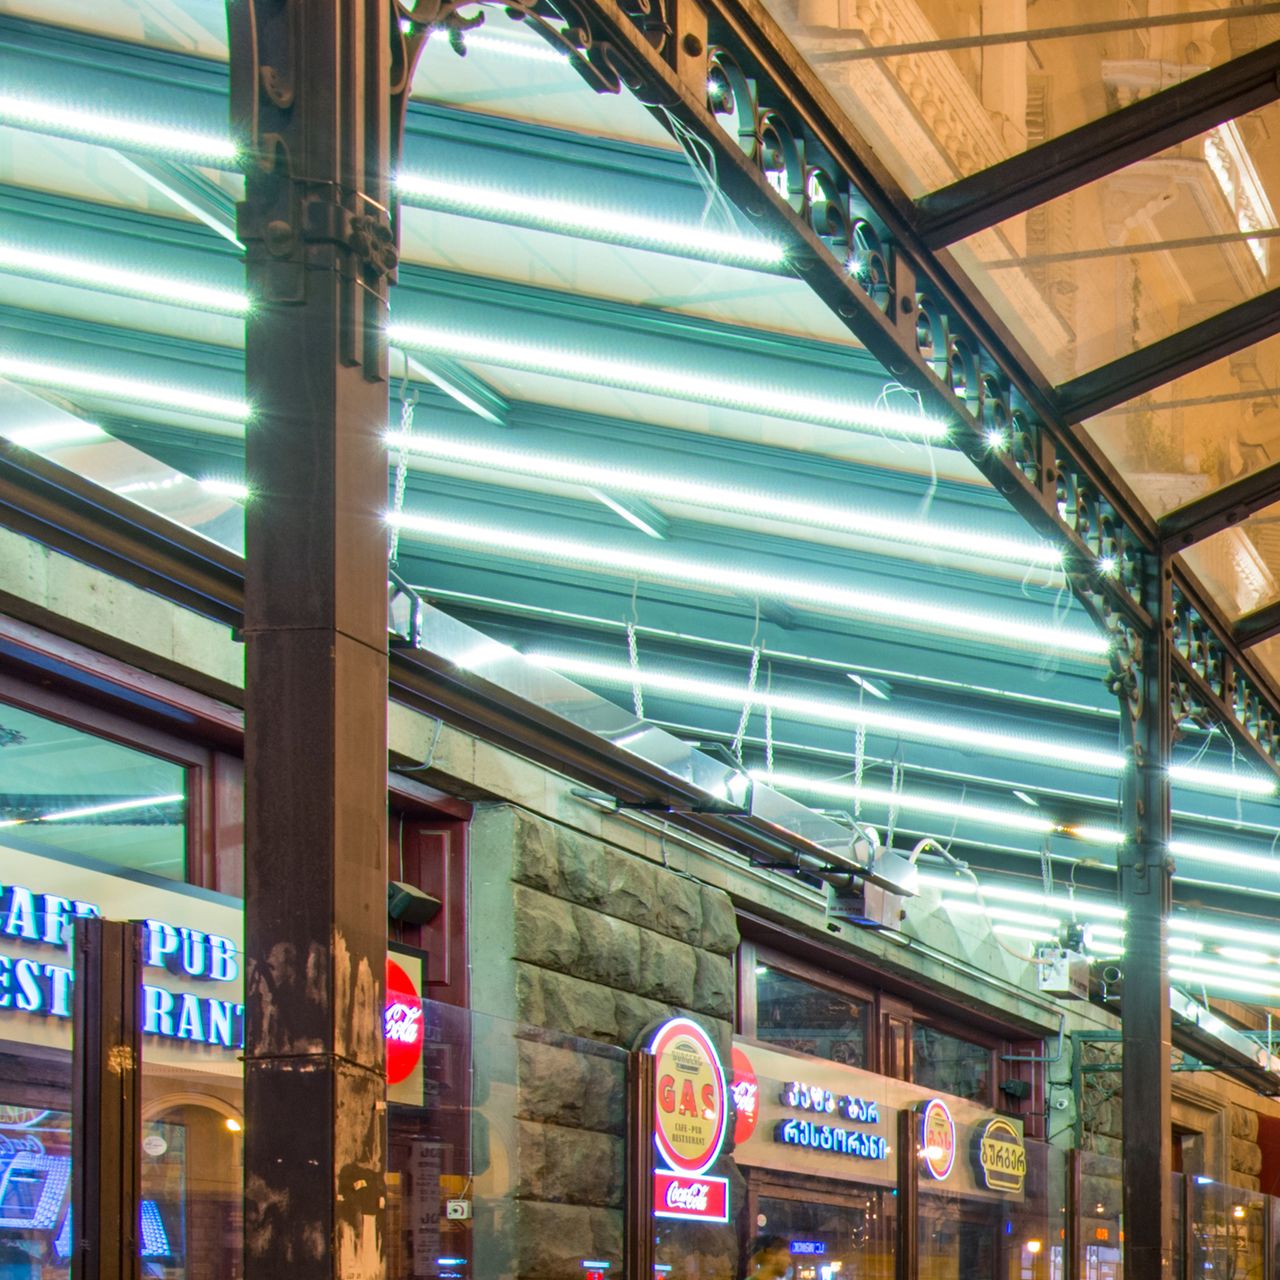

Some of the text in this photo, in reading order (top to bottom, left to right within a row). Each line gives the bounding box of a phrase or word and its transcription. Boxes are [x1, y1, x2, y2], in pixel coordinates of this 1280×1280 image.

[143, 918, 239, 982] PUB
[658, 1074, 716, 1120] GAS
[783, 1118, 887, 1160] რესტორანი
